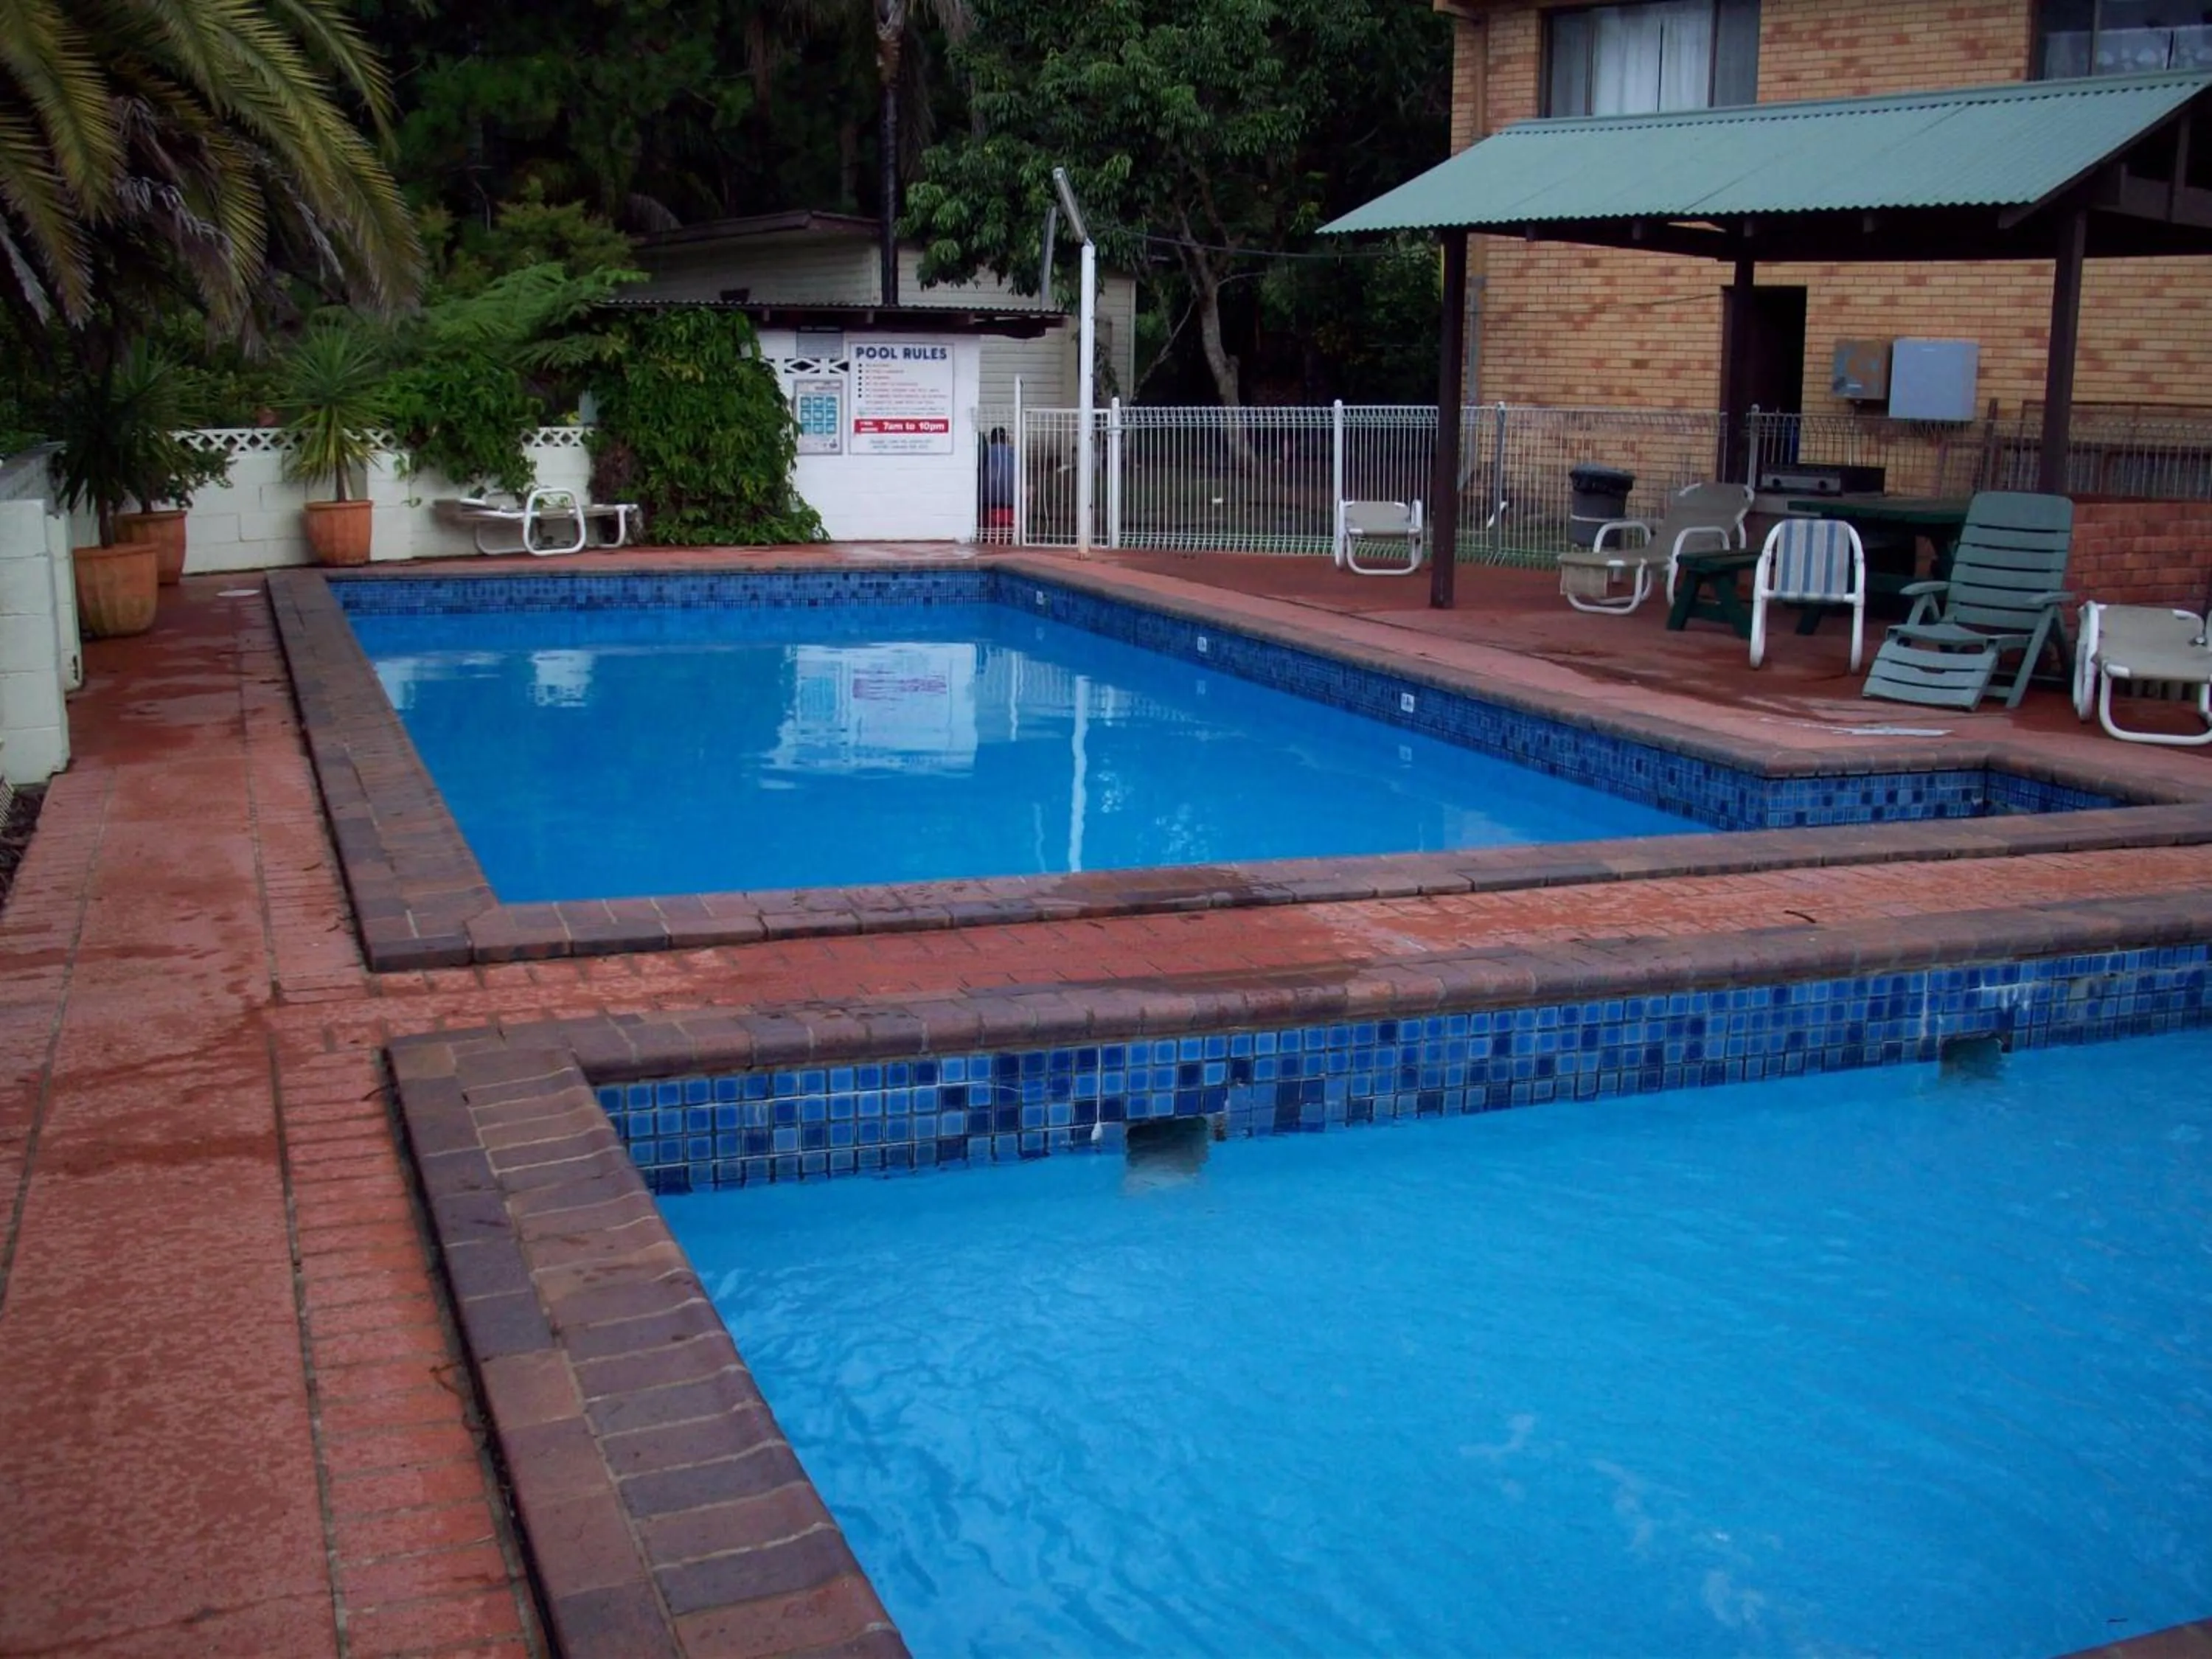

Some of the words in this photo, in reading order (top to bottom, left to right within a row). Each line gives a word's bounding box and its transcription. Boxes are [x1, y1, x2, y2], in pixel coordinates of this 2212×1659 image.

[855, 347, 897, 359] POOL
[902, 347, 947, 360] RULES
[883, 422, 903, 431] 7am
[905, 422, 915, 431] to
[919, 422, 945, 432] 10pm
